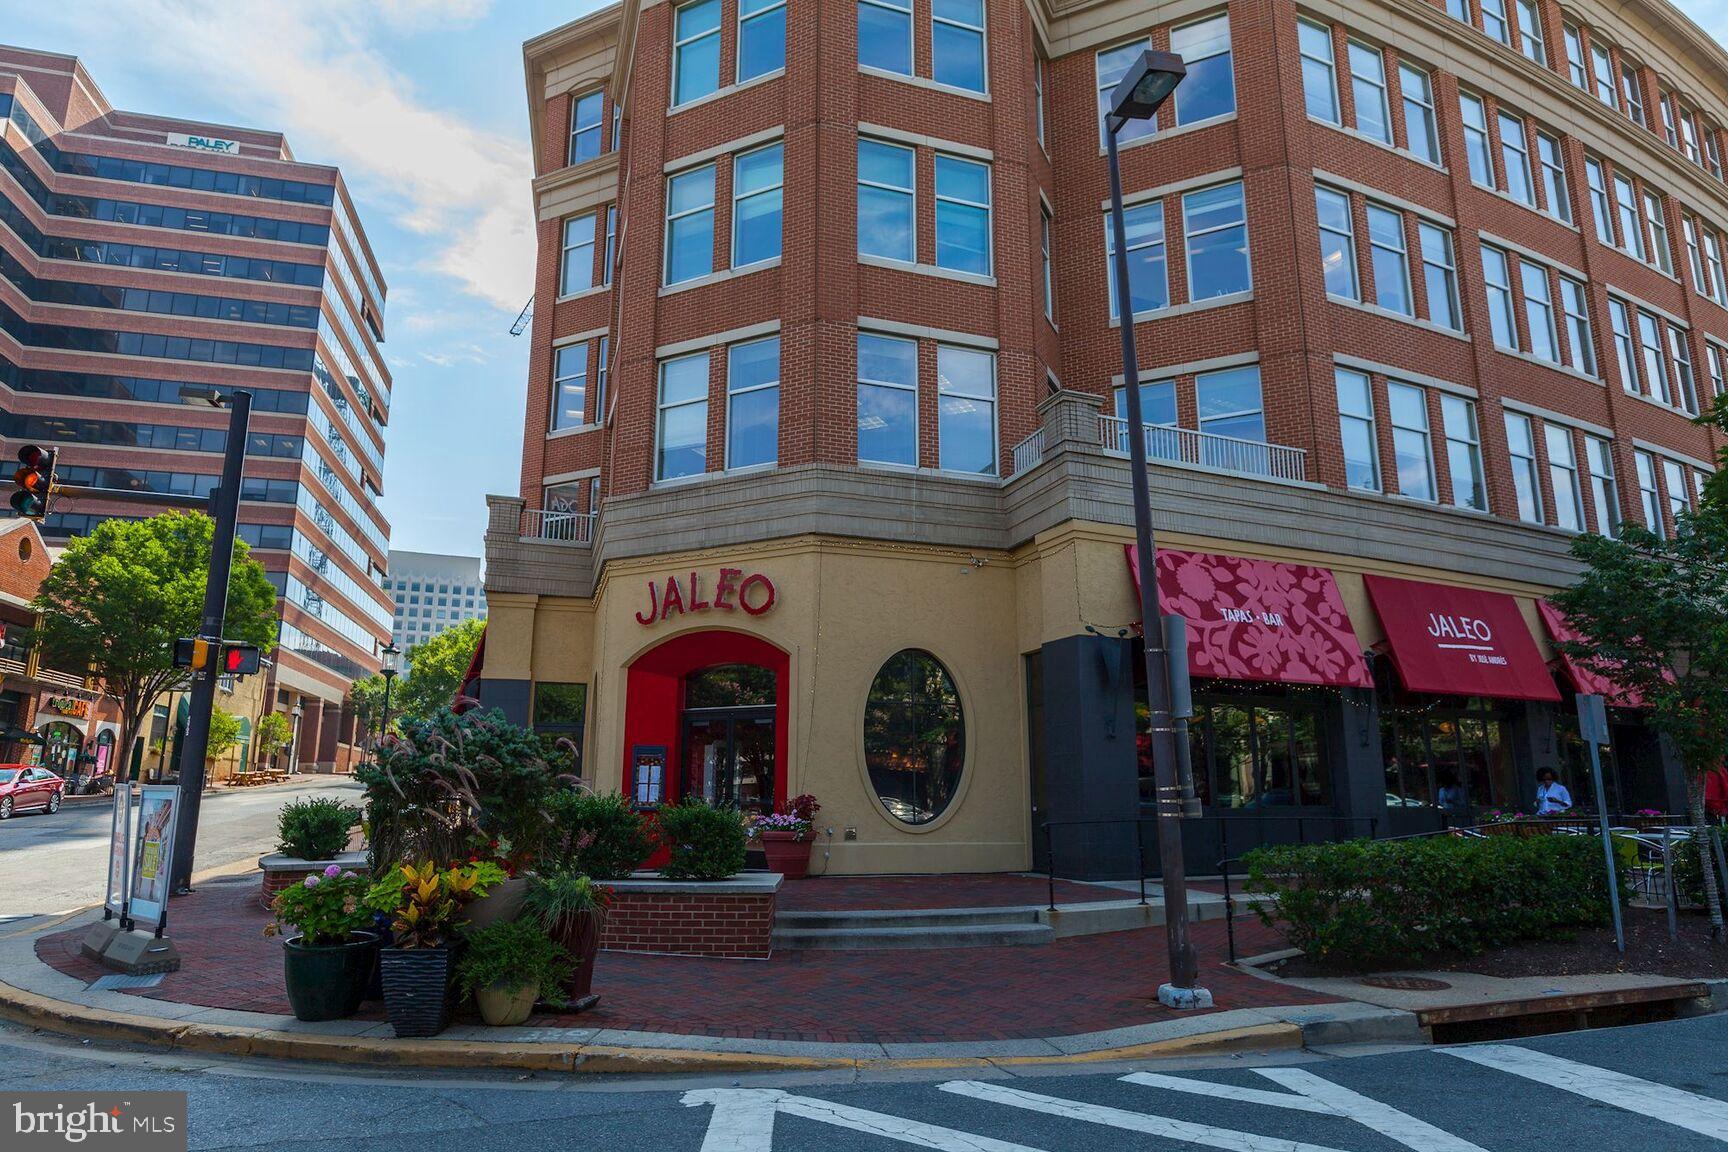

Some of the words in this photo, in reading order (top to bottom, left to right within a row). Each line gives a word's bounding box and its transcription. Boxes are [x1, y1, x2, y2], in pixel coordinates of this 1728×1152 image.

[188, 136, 234, 150] PALEY
[635, 567, 777, 625] JALEO
[1220, 607, 1254, 623] TAPAS
[1261, 611, 1284, 627] BAR
[1427, 612, 1492, 641] JALEO
